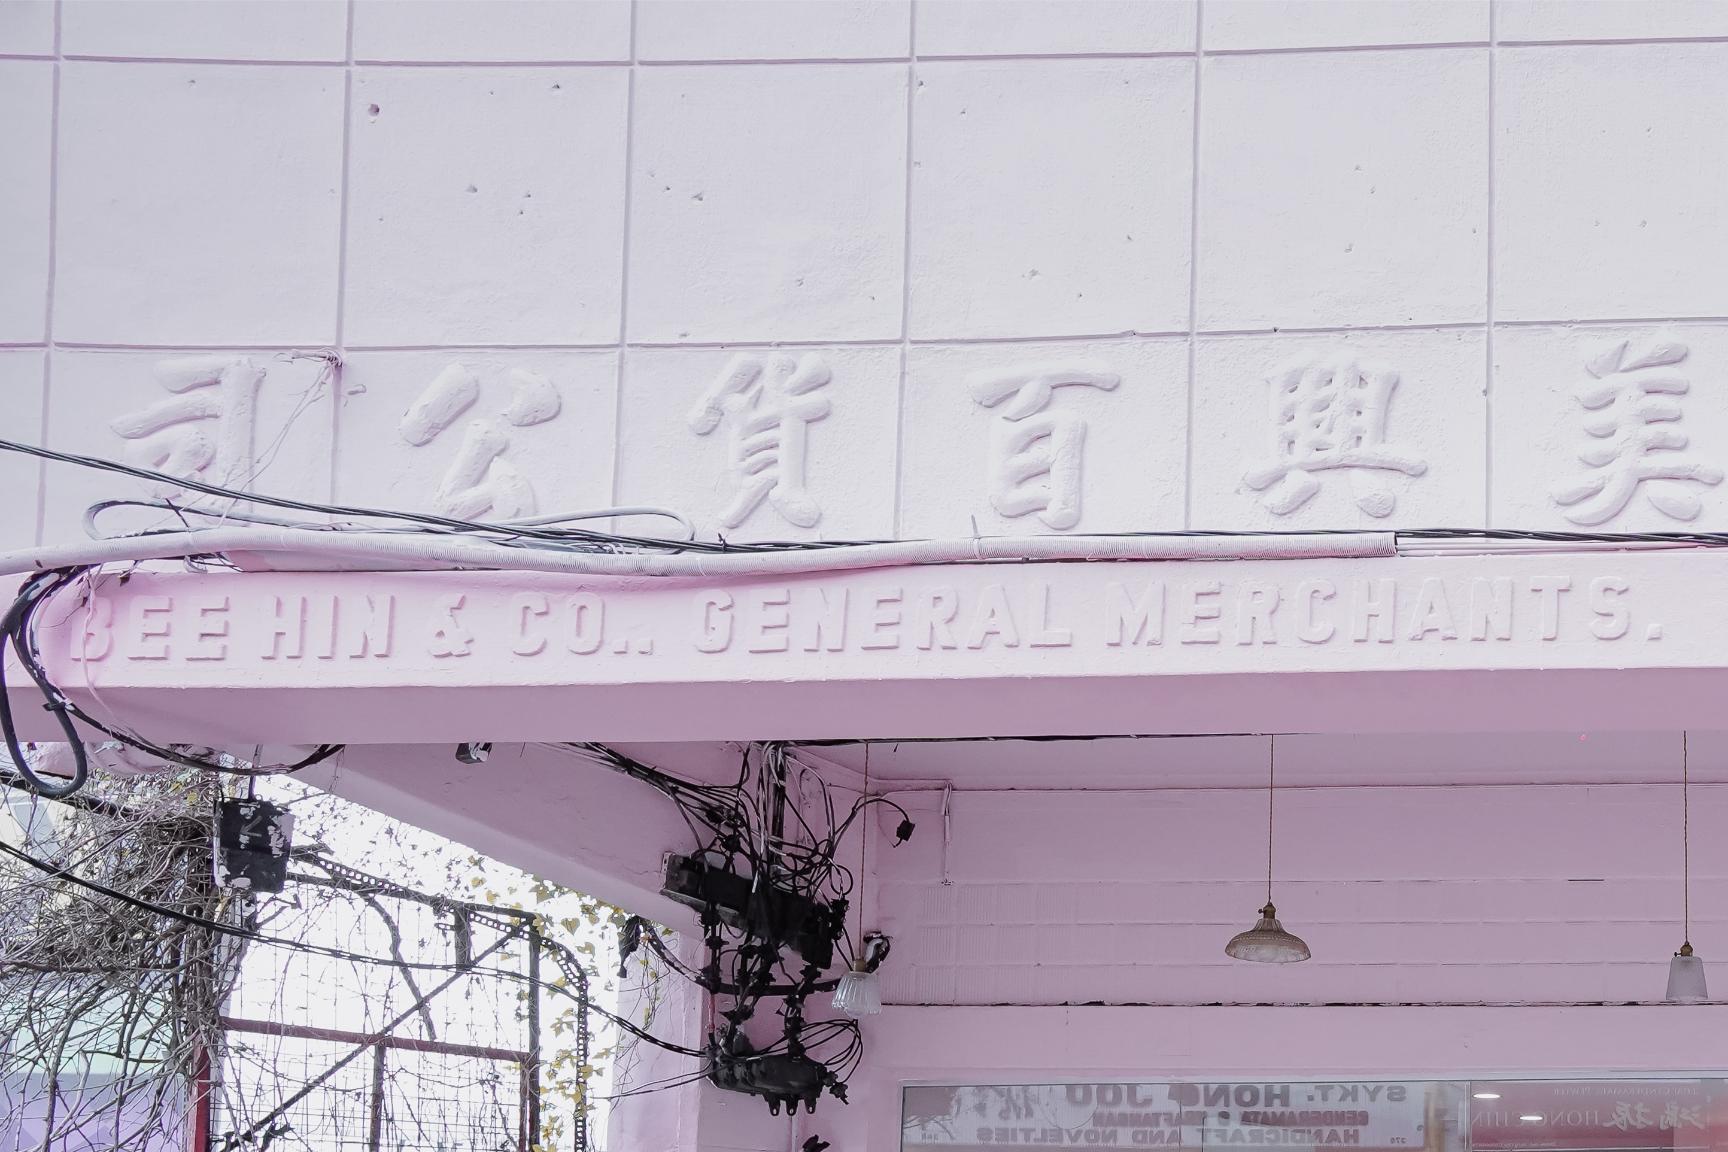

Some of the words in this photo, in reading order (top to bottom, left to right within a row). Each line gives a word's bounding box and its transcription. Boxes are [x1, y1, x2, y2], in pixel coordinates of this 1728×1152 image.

[70, 594, 231, 662] BEE
[260, 593, 396, 661] HIN
[428, 594, 472, 659] &
[693, 583, 1073, 655] GENERAL
[1105, 576, 1666, 650] MERCHANTS.
